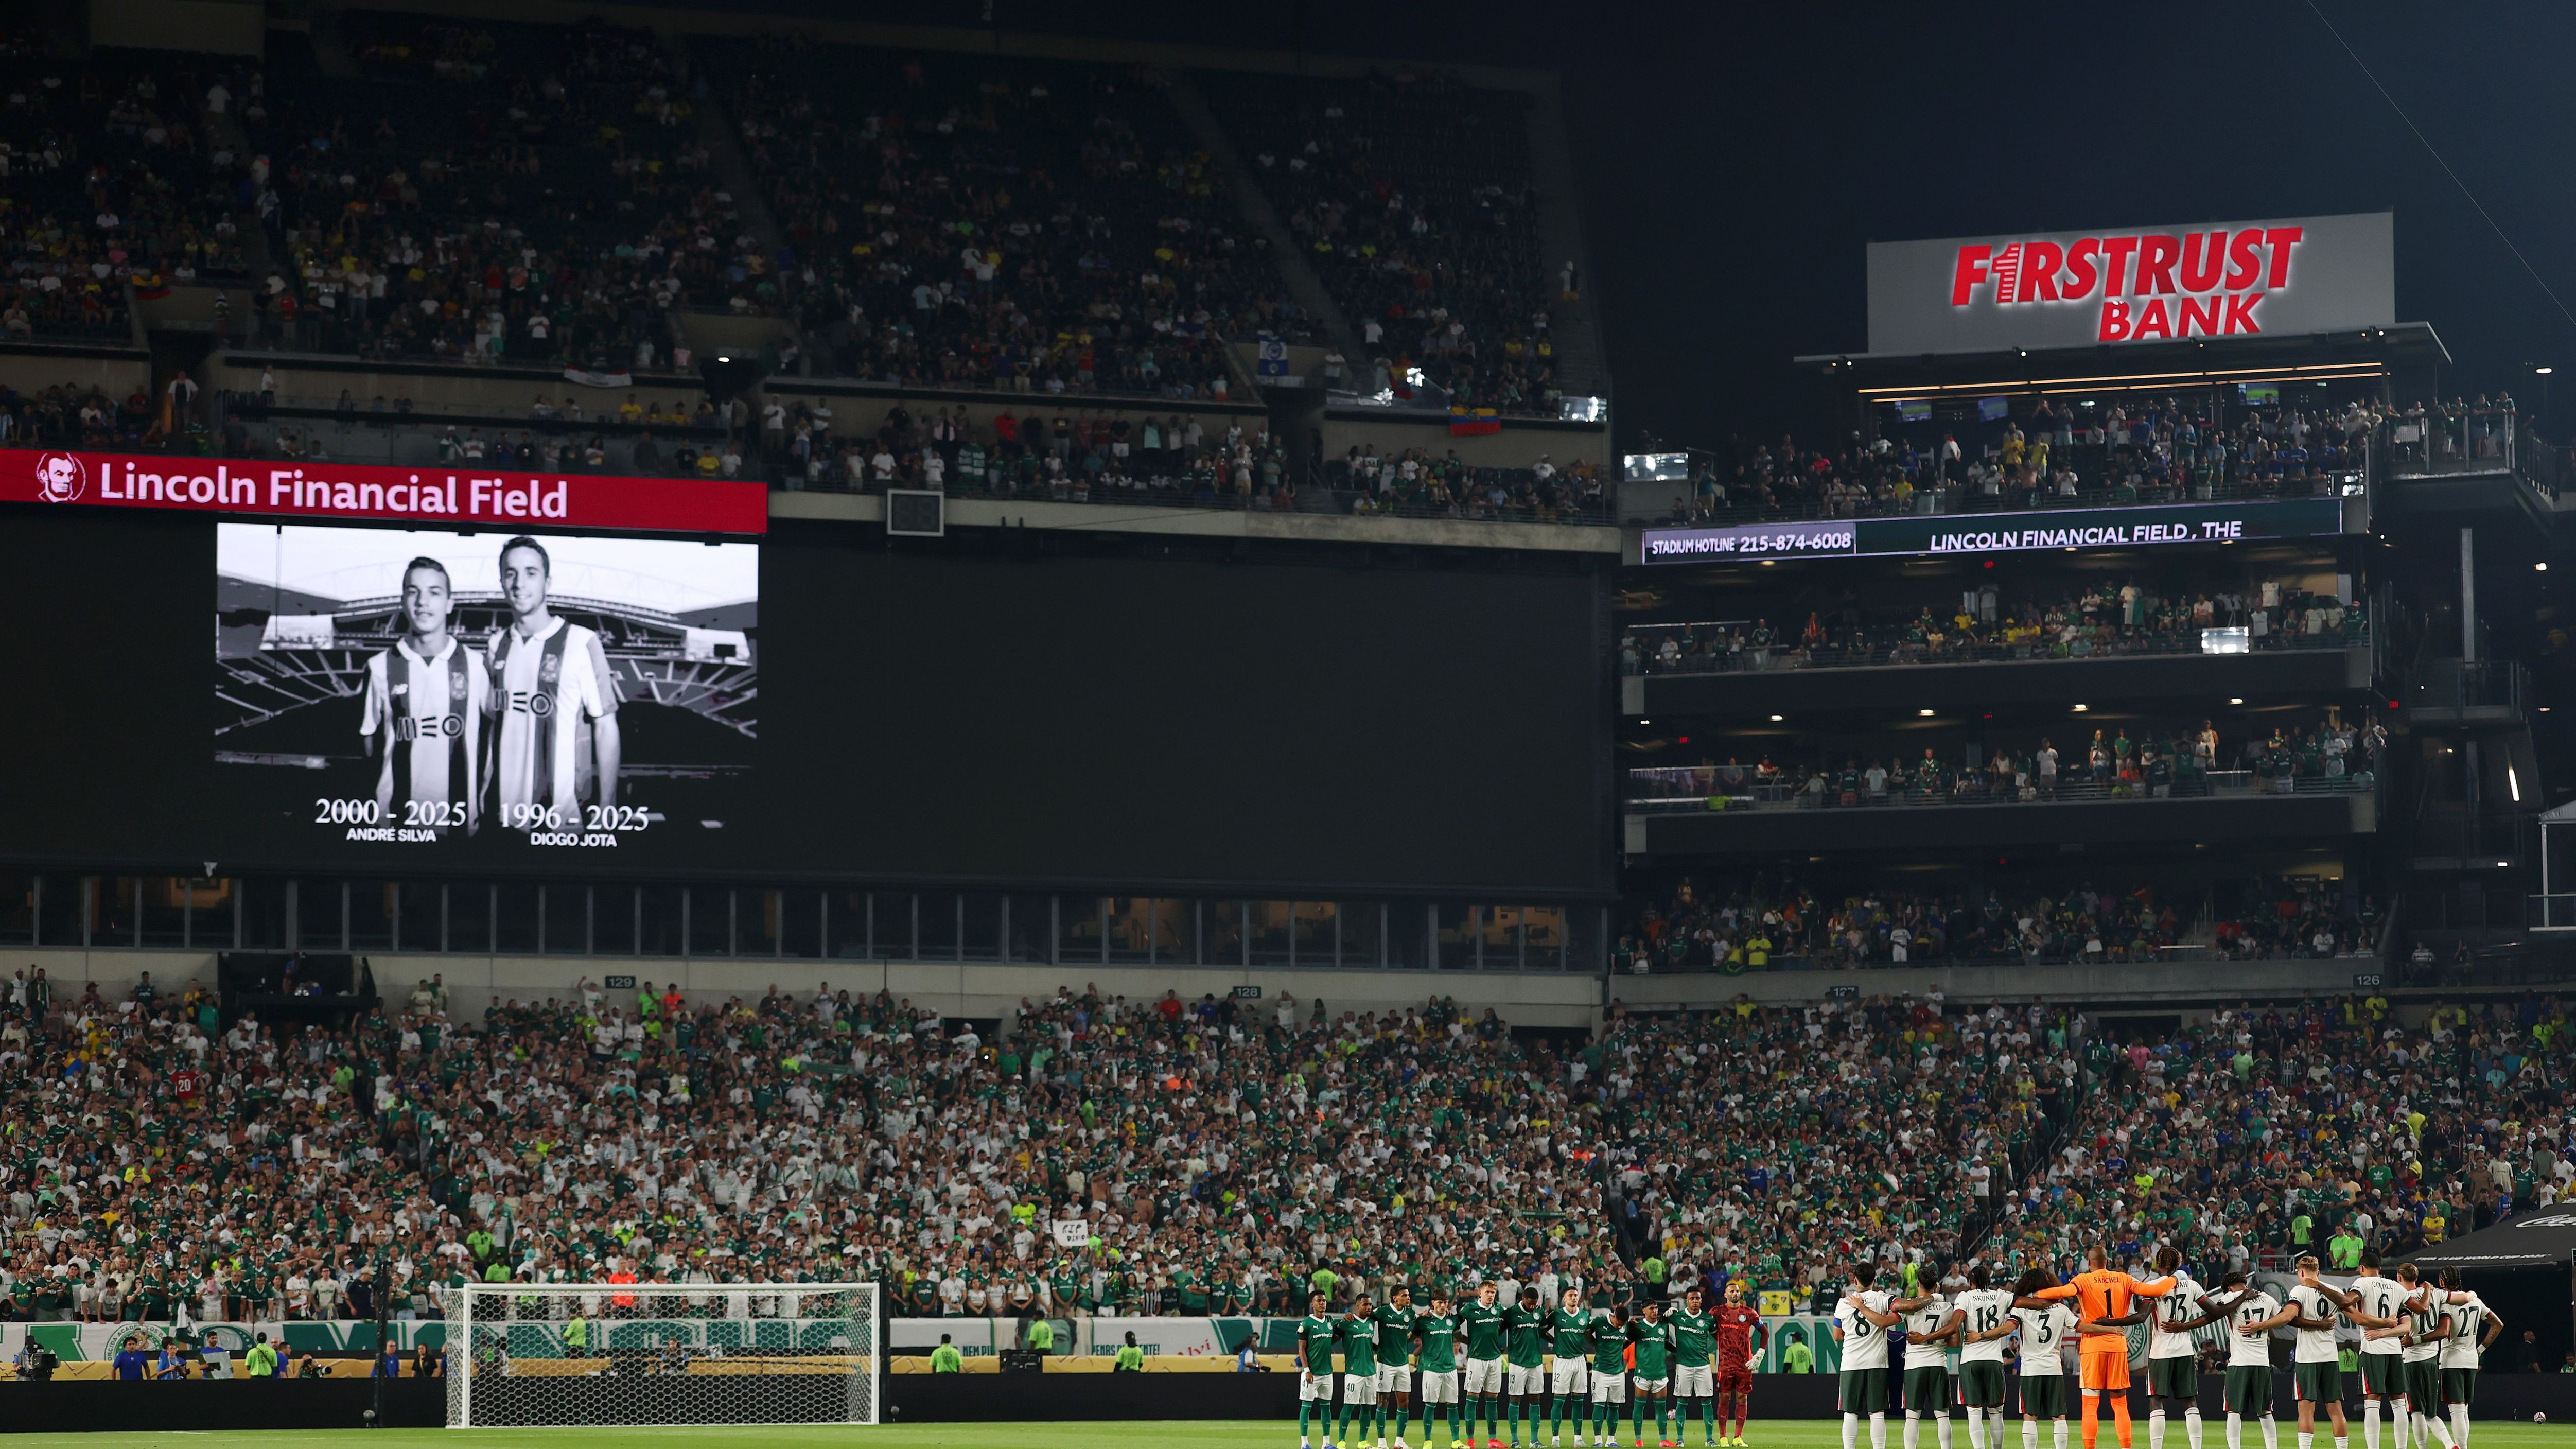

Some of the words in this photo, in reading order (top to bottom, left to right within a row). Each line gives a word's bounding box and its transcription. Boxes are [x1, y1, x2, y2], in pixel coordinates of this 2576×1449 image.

[2098, 293, 2265, 342] BANK
[101, 462, 256, 503] Lincoln
[270, 469, 459, 514] Financial
[470, 476, 567, 518] Field
[1652, 539, 1694, 555] STADIUM
[1695, 537, 1736, 553] HOTLINE
[1739, 532, 1851, 553] 215-874-6008
[1930, 531, 2018, 551] LINCOLN
[2022, 526, 2129, 547] FINANCIAL
[2132, 523, 2187, 542] FIELD
[2202, 520, 2242, 538] THE
[315, 798, 379, 824] 2000
[404, 800, 466, 827] 2025
[500, 802, 562, 829] 1996
[586, 805, 649, 831] 2025
[346, 826, 396, 842] ANDRÉ
[397, 828, 436, 842] SILVA
[531, 832, 579, 846] DIOGO
[580, 833, 618, 847] JOTA
[609, 977, 633, 988] 129
[1236, 987, 1258, 997] 128
[2357, 975, 2380, 986] 126
[178, 1078, 191, 1092] 20
[1062, 1224, 1081, 1233] RIP
[2104, 1288, 2114, 1318] 1
[2164, 1294, 2187, 1323] 23
[2317, 1298, 2328, 1321] 9
[2378, 1293, 2390, 1318] 6
[1853, 1307, 1870, 1337] 8
[1925, 1314, 1940, 1344] 7
[1976, 1304, 1999, 1333] 18
[2038, 1314, 2052, 1343] 3
[2242, 1308, 2264, 1338] 17
[2418, 1303, 2438, 1334] 10
[2457, 1306, 2480, 1337] 27
[1346, 1383, 1355, 1392] 40
[1379, 1371, 1383, 1380] 8
[1510, 1374, 1515, 1384] 13
